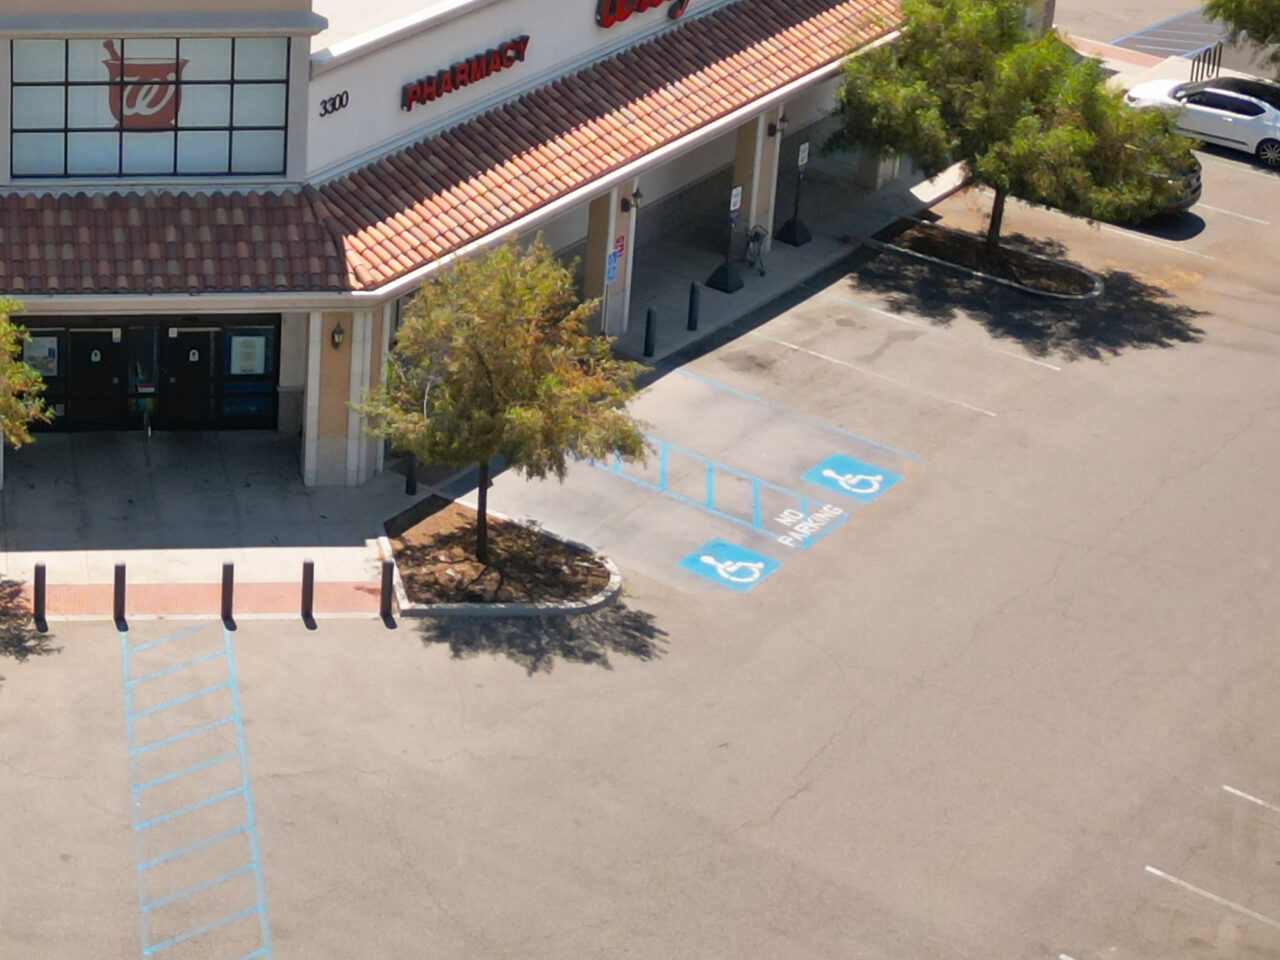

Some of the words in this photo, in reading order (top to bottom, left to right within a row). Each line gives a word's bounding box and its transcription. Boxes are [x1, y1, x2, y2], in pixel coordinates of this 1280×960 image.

[401, 35, 530, 111] PHARMACY
[320, 91, 349, 117] 3300
[774, 509, 804, 527] NO
[776, 504, 844, 547] PARKING
